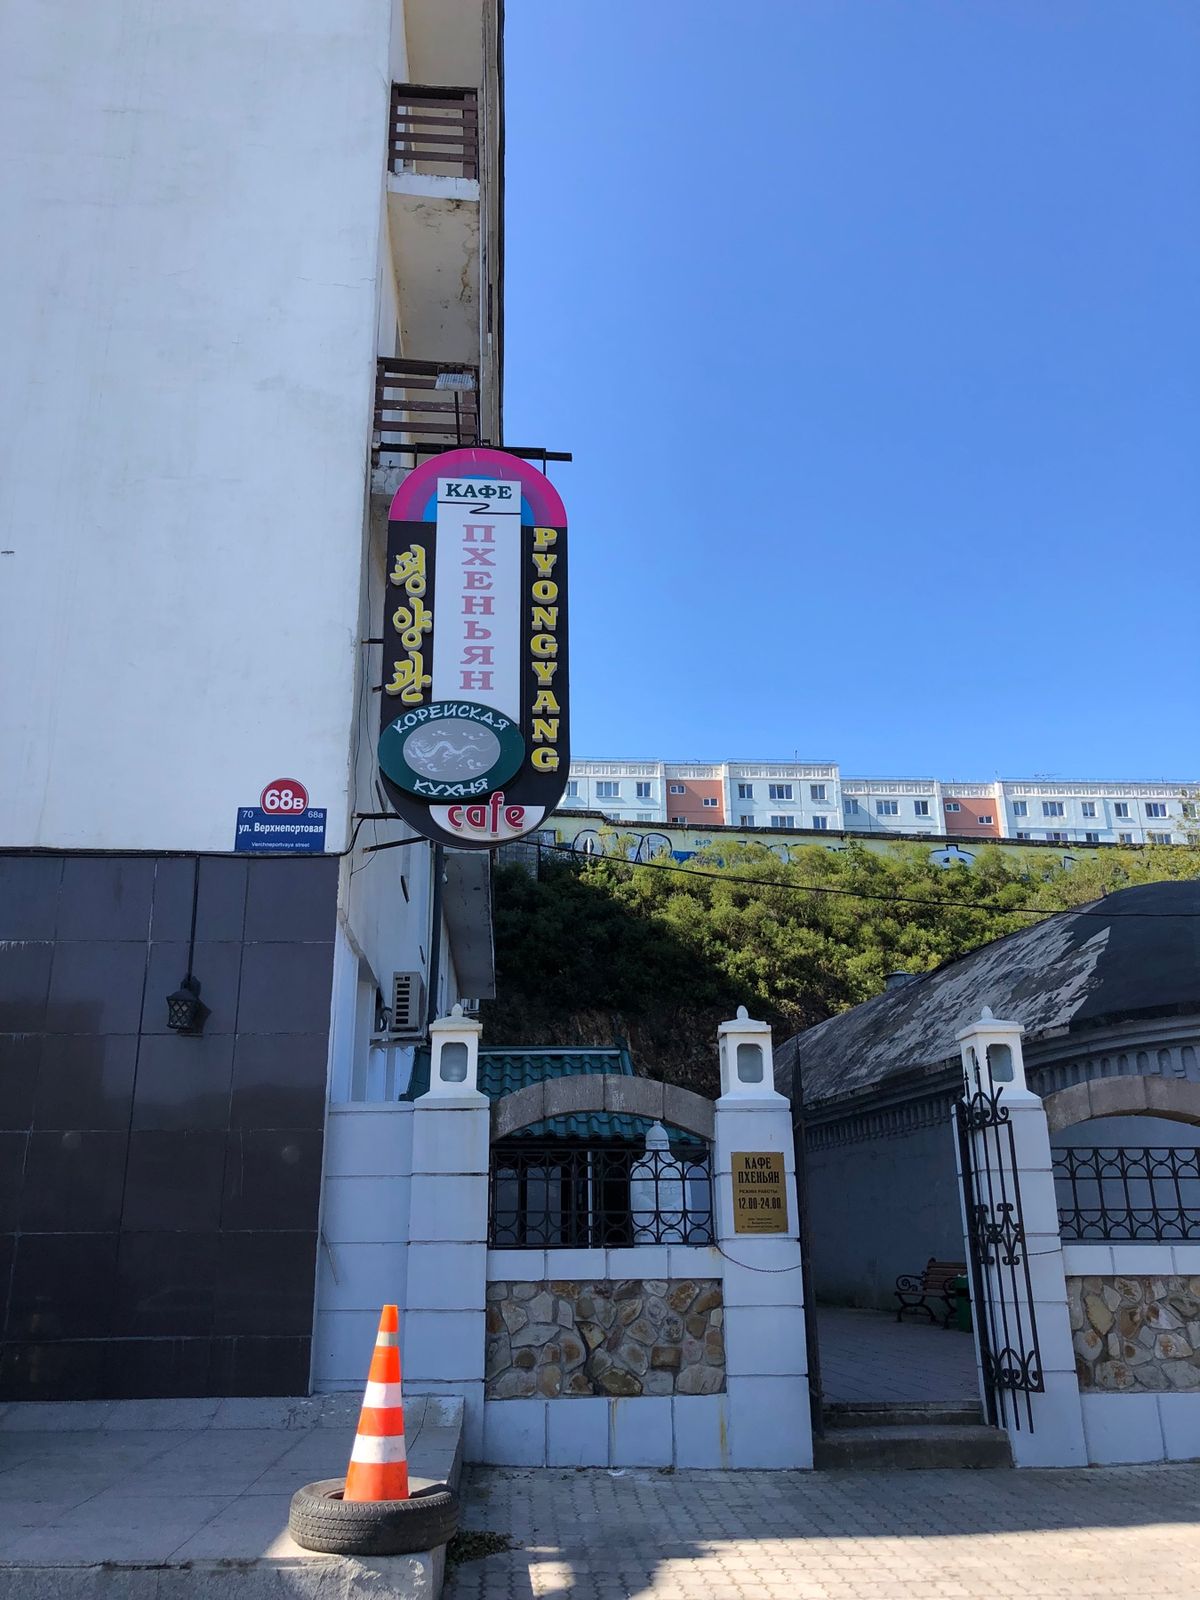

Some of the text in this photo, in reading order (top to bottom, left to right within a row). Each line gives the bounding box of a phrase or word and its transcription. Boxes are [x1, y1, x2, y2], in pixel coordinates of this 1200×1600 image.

[445, 483, 512, 500] КАФЕ
[459, 524, 496, 690] ПХЕНЬЯН
[385, 544, 433, 706] 평양관
[530, 527, 560, 773] PYONGYANG
[392, 703, 510, 734] КОРЕЙСКАЯ
[413, 778, 488, 796] КУХНЯ
[242, 810, 254, 818] 70
[447, 791, 526, 835] cafe
[238, 822, 323, 834] ул. Верхнепортовая
[745, 1157, 772, 1169] КАФЕ
[738, 1171, 779, 1183] ПХЕНЬЯН
